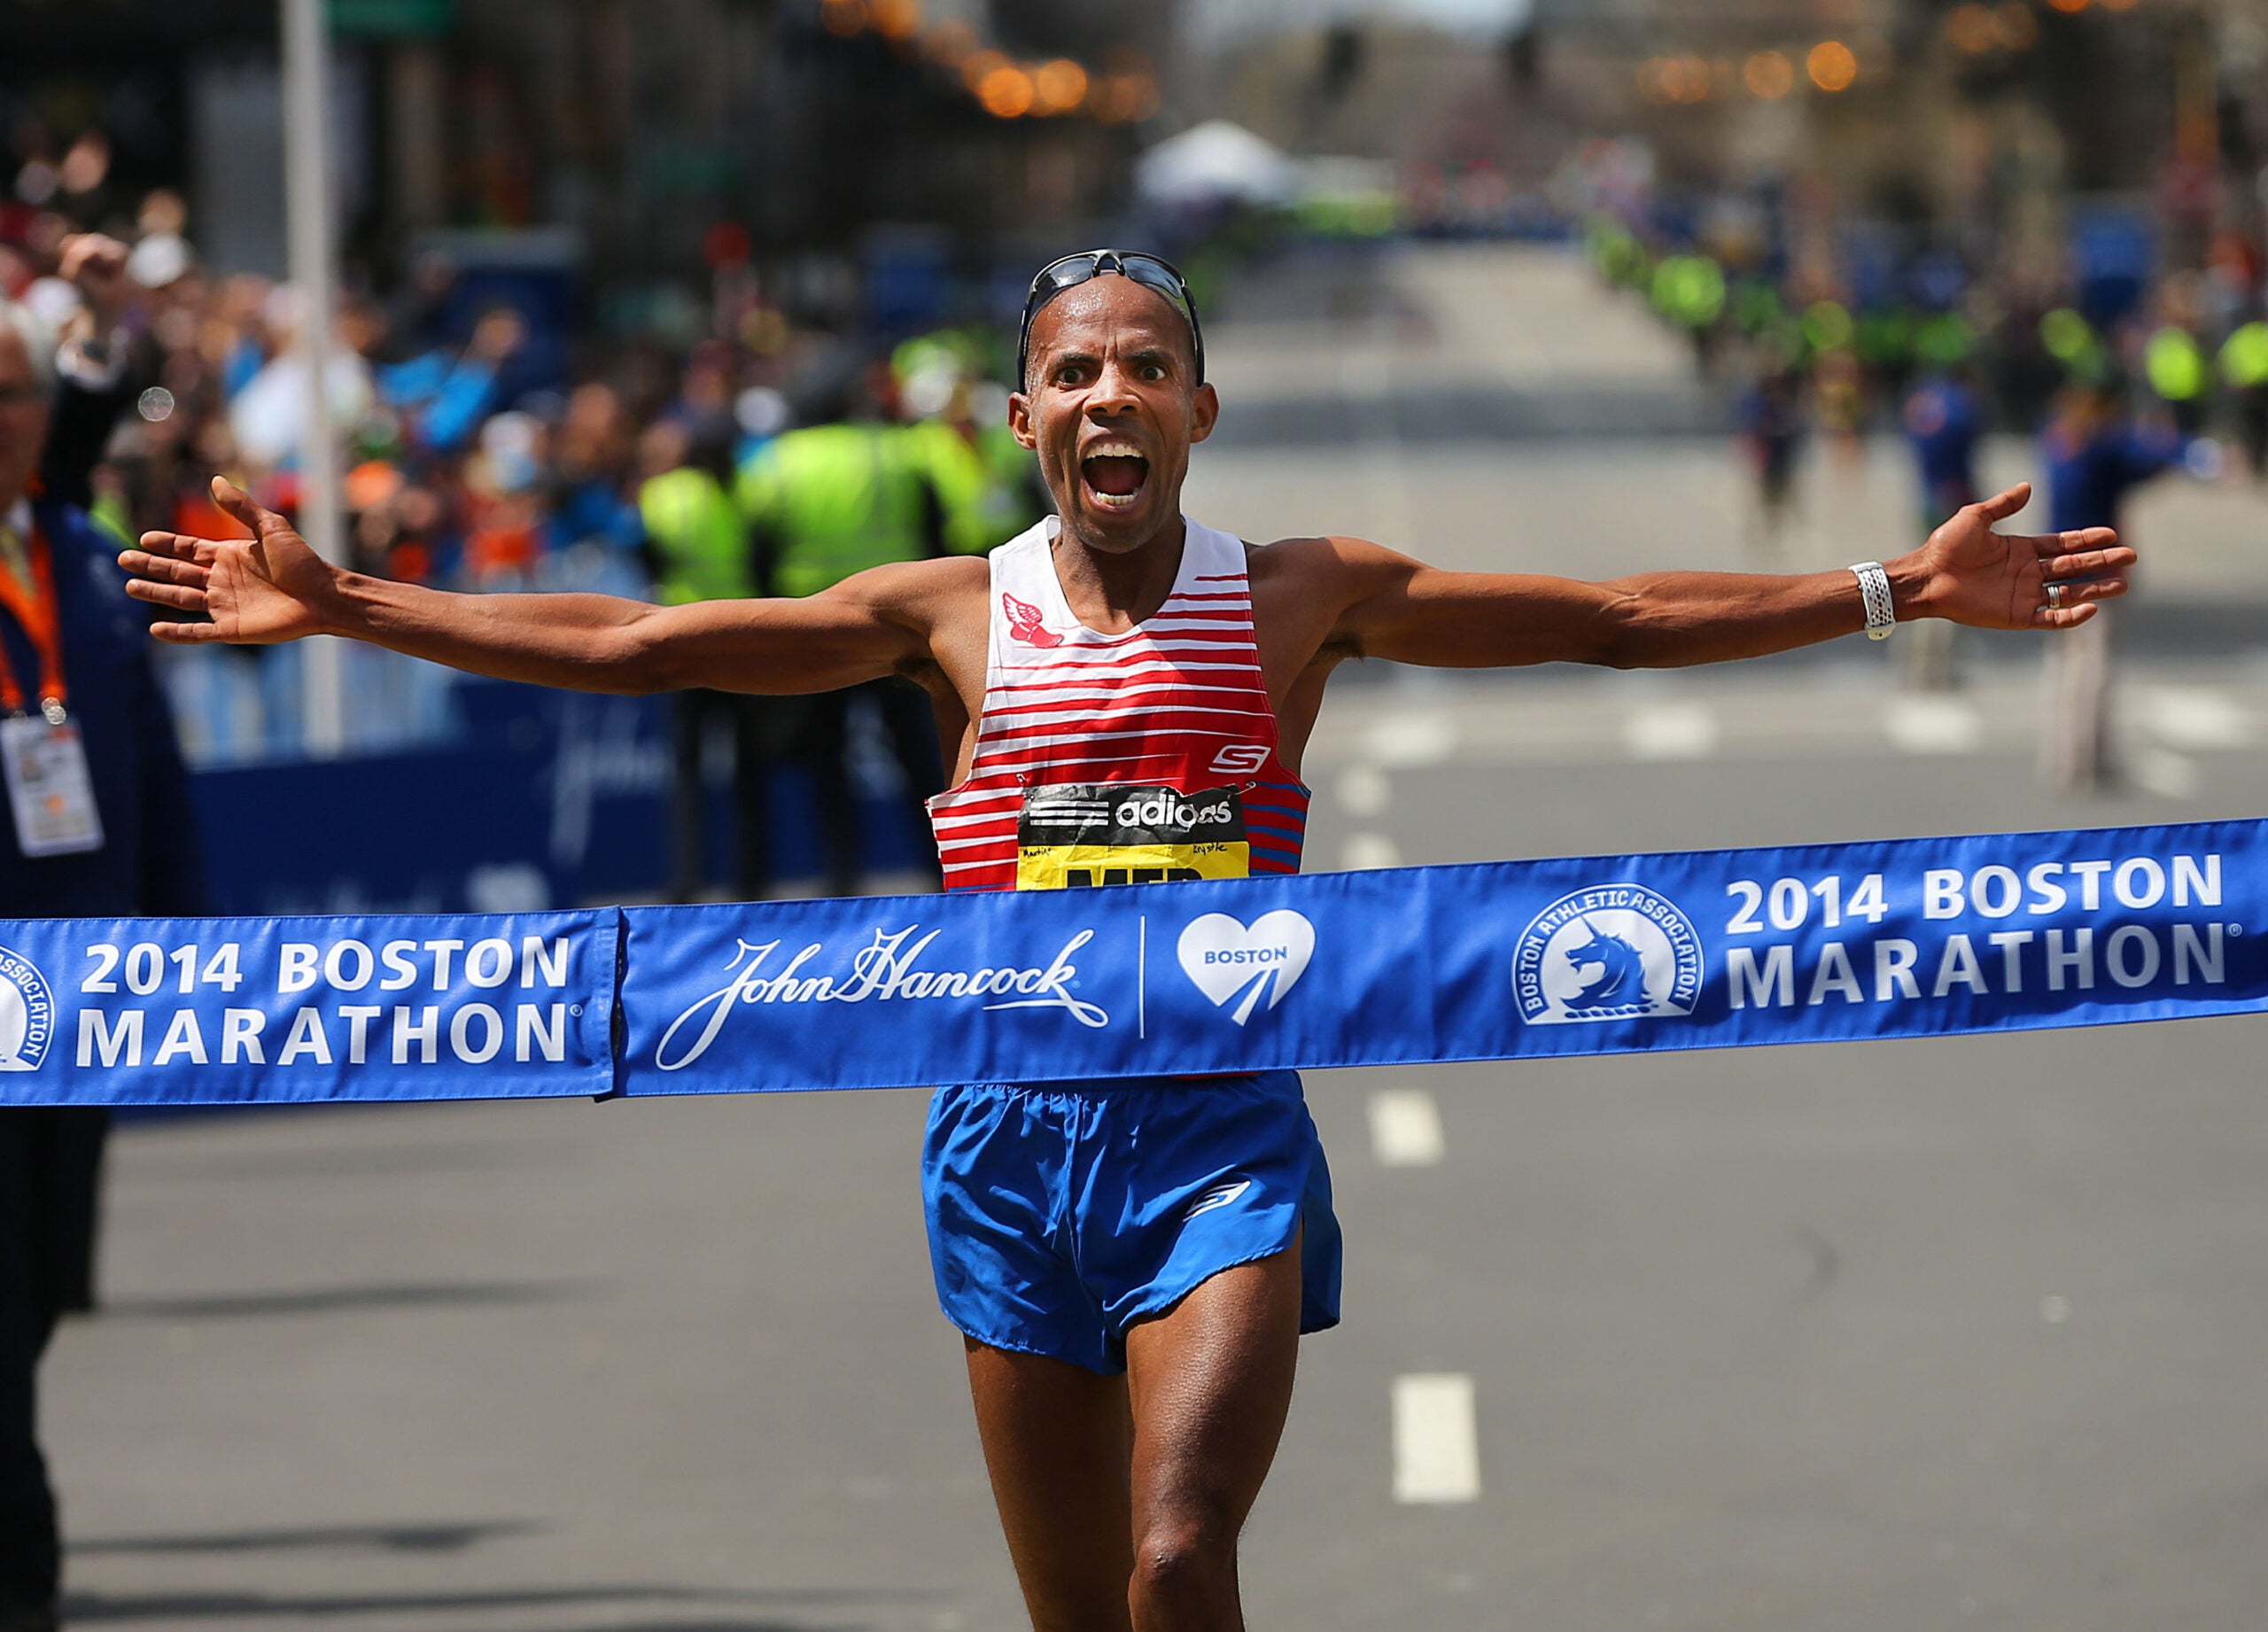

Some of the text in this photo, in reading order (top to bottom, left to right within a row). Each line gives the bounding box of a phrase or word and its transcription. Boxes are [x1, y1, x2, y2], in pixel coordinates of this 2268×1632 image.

[1726, 854, 2222, 935] 2014 BOSTON
[80, 936, 570, 996] 2014 BOSTON
[1205, 945, 1287, 964] BOSTON
[1520, 890, 1697, 1012] BOSTON ATHLETIC ASSOCIATION
[656, 924, 1109, 1070] John Hancock
